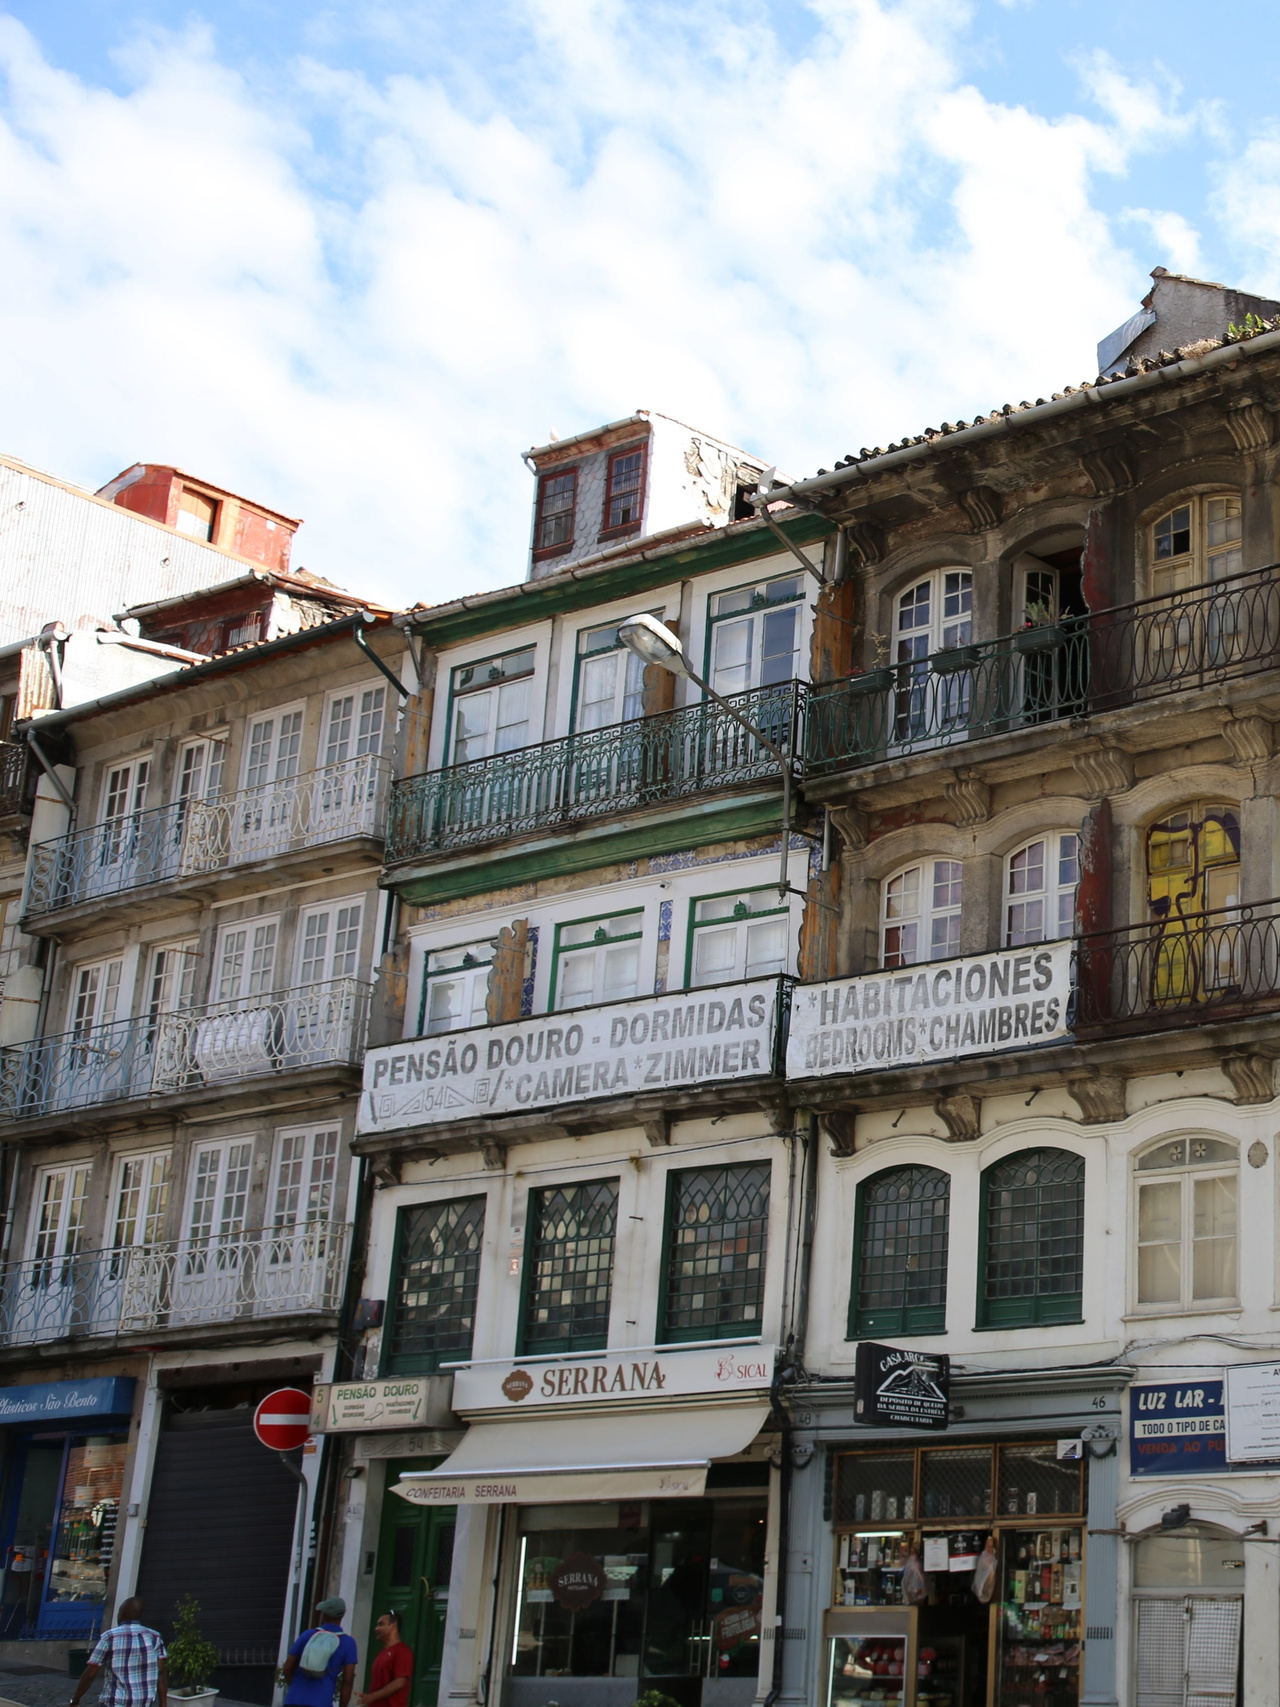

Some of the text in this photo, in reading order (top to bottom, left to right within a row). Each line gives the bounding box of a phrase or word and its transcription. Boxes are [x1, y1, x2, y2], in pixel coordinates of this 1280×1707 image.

[819, 952, 1054, 1026] HABITACIONES
[373, 1040, 478, 1089] PENSÃO
[487, 1024, 584, 1070] DOURO
[610, 994, 766, 1049] DORMIDAS
[424, 1085, 445, 1111] 54
[880, 1352, 902, 1372] CASA
[541, 1361, 666, 1397] SERRANA
[737, 1363, 768, 1379] SICAL
[336, 1384, 419, 1400] PENSÃO DOURO
[1138, 1392, 1167, 1410] LUZ
[1174, 1389, 1205, 1408] LAR
[40, 1393, 61, 1410] São
[63, 1391, 98, 1409] Bento
[888, 1404, 909, 1412] SERRA
[1092, 1395, 1106, 1409] 46
[890, 1414, 933, 1424] CHARCUTARIA
[1142, 1422, 1165, 1435] TODO
[1167, 1422, 1173, 1433] O
[1175, 1420, 1197, 1433] TIPO
[1199, 1420, 1210, 1431] DE
[1137, 1441, 1178, 1455] VENDA
[1184, 1440, 1202, 1452] AO
[406, 1485, 517, 1499] CONFEITARIA SERRANA
[558, 1572, 598, 1588] SERRANA
